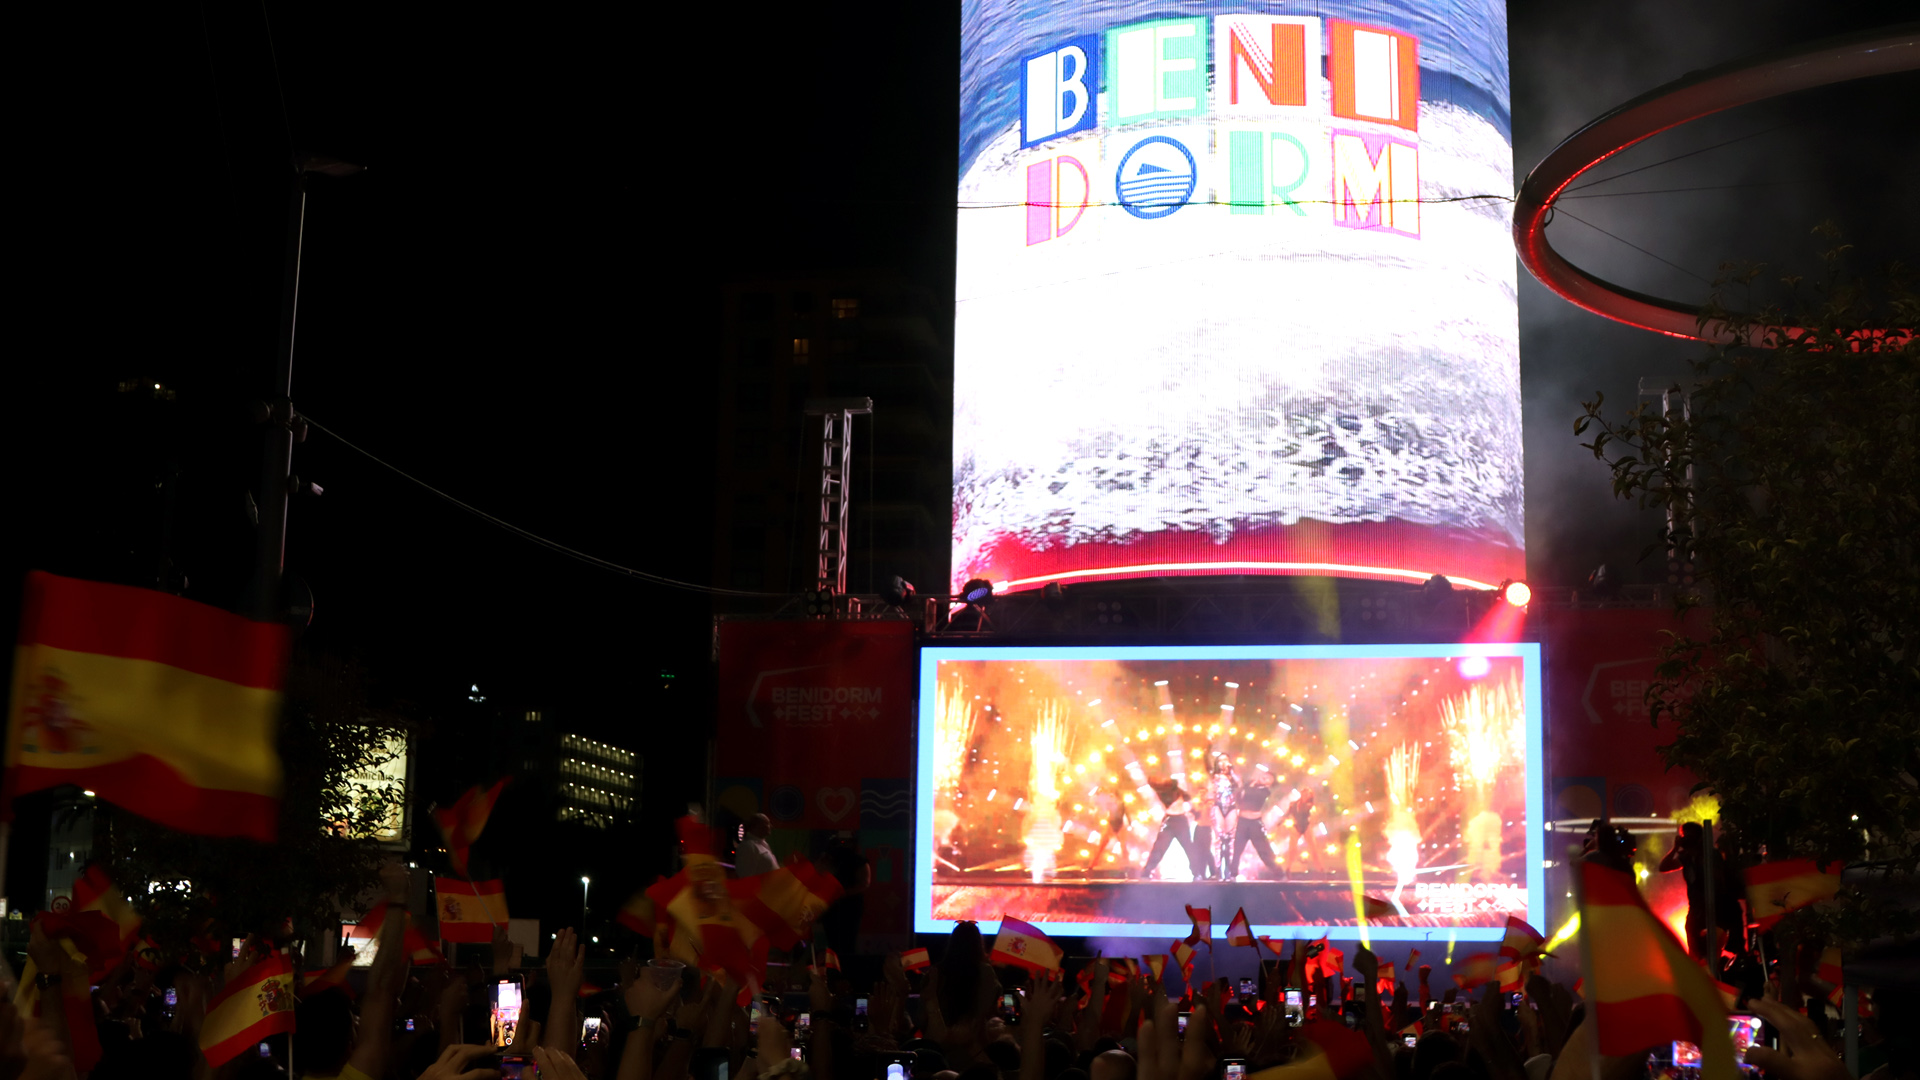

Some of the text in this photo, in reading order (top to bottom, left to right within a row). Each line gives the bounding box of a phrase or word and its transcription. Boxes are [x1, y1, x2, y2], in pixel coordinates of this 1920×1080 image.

[1021, 15, 1420, 148] BENI
[771, 687, 882, 704] BENIDORM
[785, 704, 837, 721] FEST
[1415, 883, 1519, 898] BENIDORM
[55, 902, 68, 910] 20
[1428, 898, 1477, 912] FEST
